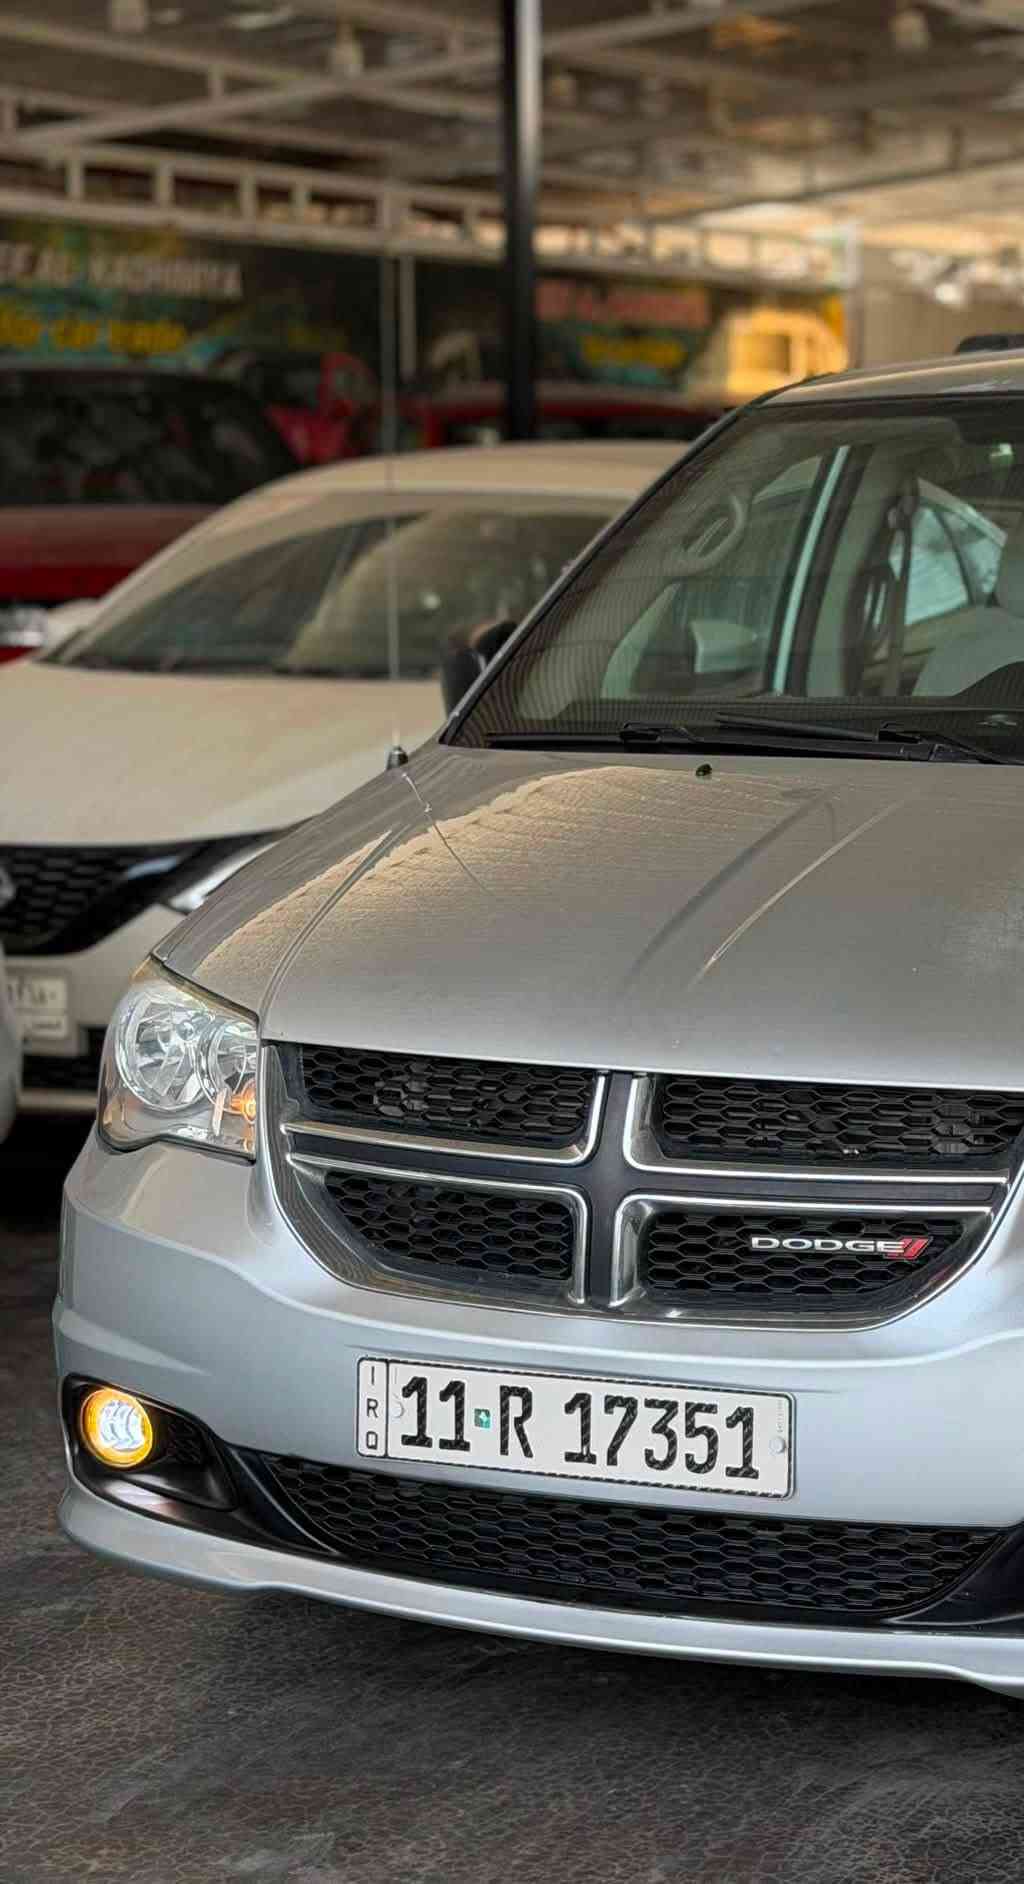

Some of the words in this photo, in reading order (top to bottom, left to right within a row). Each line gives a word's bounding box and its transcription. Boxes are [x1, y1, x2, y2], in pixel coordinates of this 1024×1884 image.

[751, 1236, 904, 1253] DODGE
[365, 1365, 379, 1450] IRQ
[401, 1376, 471, 1452] 11
[499, 1385, 534, 1459] R
[564, 1392, 760, 1480] 17351
